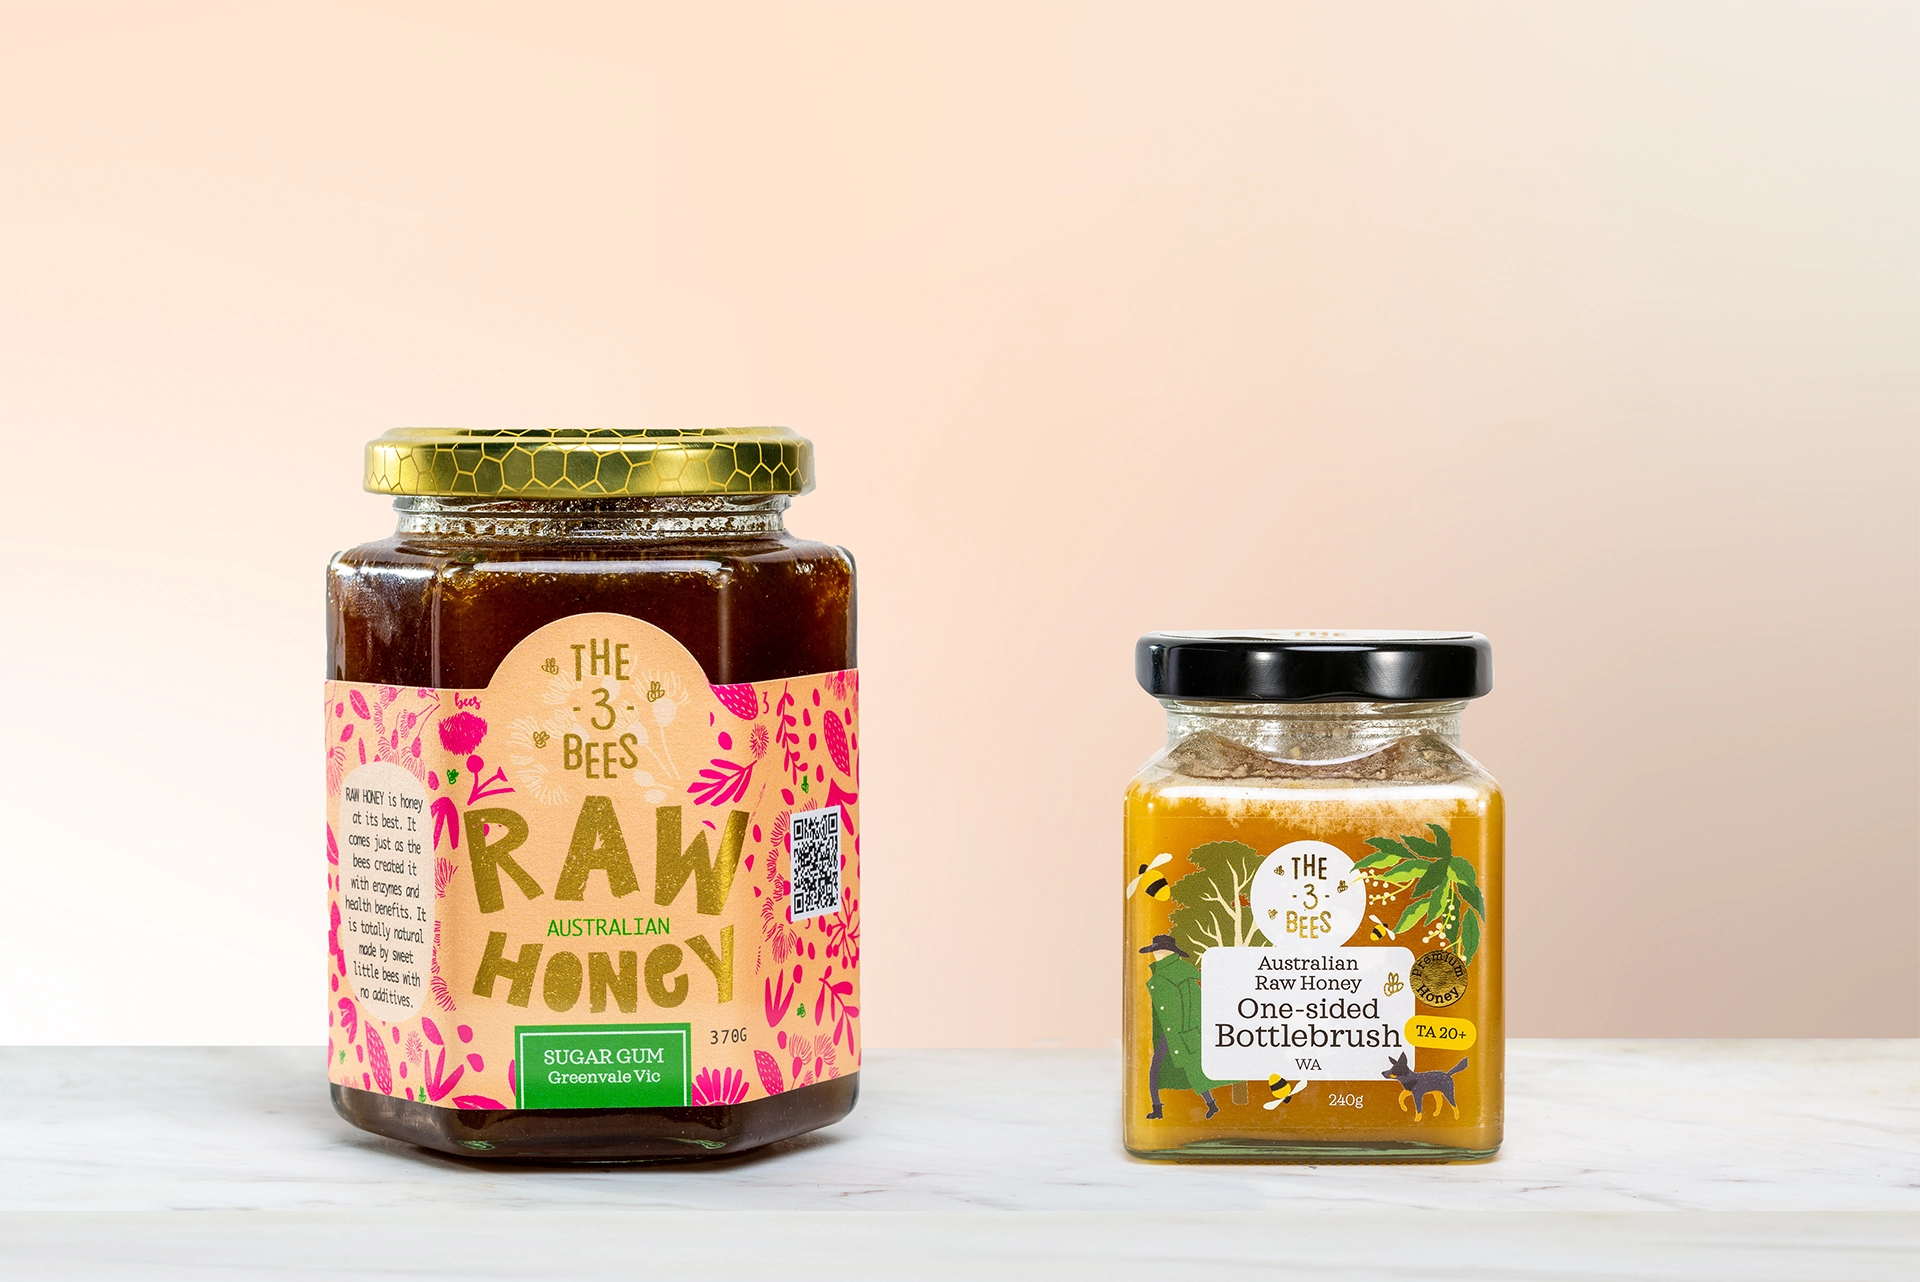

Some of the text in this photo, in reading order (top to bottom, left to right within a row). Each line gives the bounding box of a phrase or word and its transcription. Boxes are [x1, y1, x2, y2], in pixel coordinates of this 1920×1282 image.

[571, 638, 630, 682] THE
[455, 692, 481, 709] bees
[563, 732, 638, 780] BEES
[346, 787, 423, 813] RAW HONEY is honey
[353, 811, 416, 832] at its best. It
[349, 834, 421, 854] comes just as the
[353, 853, 417, 876] bees created it
[464, 796, 750, 916] RAW
[1292, 854, 1327, 882] THE
[351, 875, 419, 898] with enzymes and
[346, 895, 426, 922] health benefits. It
[348, 917, 424, 943] is totally natural
[547, 918, 670, 938] AUSTRALIAN
[1286, 911, 1331, 939] BEES
[359, 942, 413, 964] made by sweet
[1257, 956, 1358, 971] Australian
[354, 961, 420, 987] little bees with
[1412, 952, 1464, 977] Premium
[1255, 976, 1362, 995] Raw Honey
[1416, 984, 1459, 1004] Honey
[360, 988, 413, 1008] no additives.
[1238, 998, 1380, 1020] One-sided
[710, 1028, 747, 1044] 370G
[1215, 1024, 1402, 1048] Bottlebrush
[1416, 1025, 1466, 1040] TA 20+
[544, 1048, 664, 1066] SUGAR GUM
[1295, 1059, 1322, 1071] WA
[548, 1070, 661, 1085] Greenvale Vic
[1328, 1094, 1363, 1108] 240g
